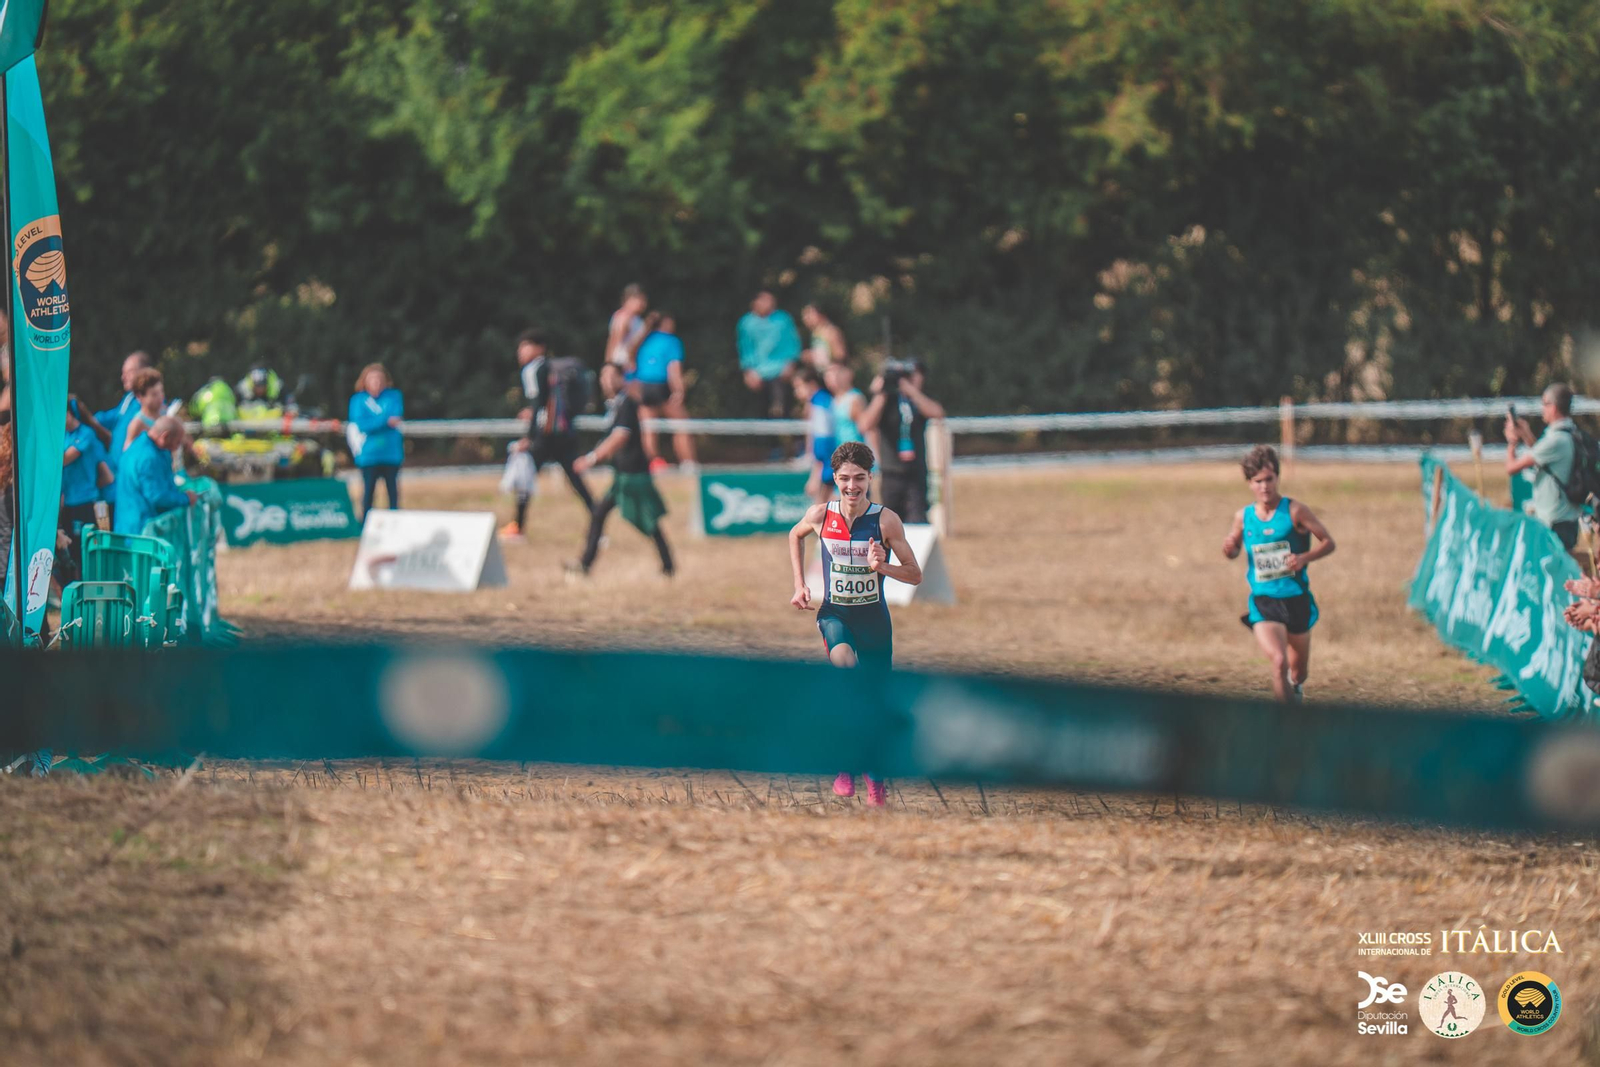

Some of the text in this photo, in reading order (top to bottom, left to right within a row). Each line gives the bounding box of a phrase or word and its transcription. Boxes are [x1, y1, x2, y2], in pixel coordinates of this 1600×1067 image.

[17, 226, 43, 249] LEVEL
[37, 294, 66, 306] WORLD
[30, 303, 70, 318] ATHLETICS
[33, 333, 60, 343] WORLD
[835, 579, 876, 594] 6400
